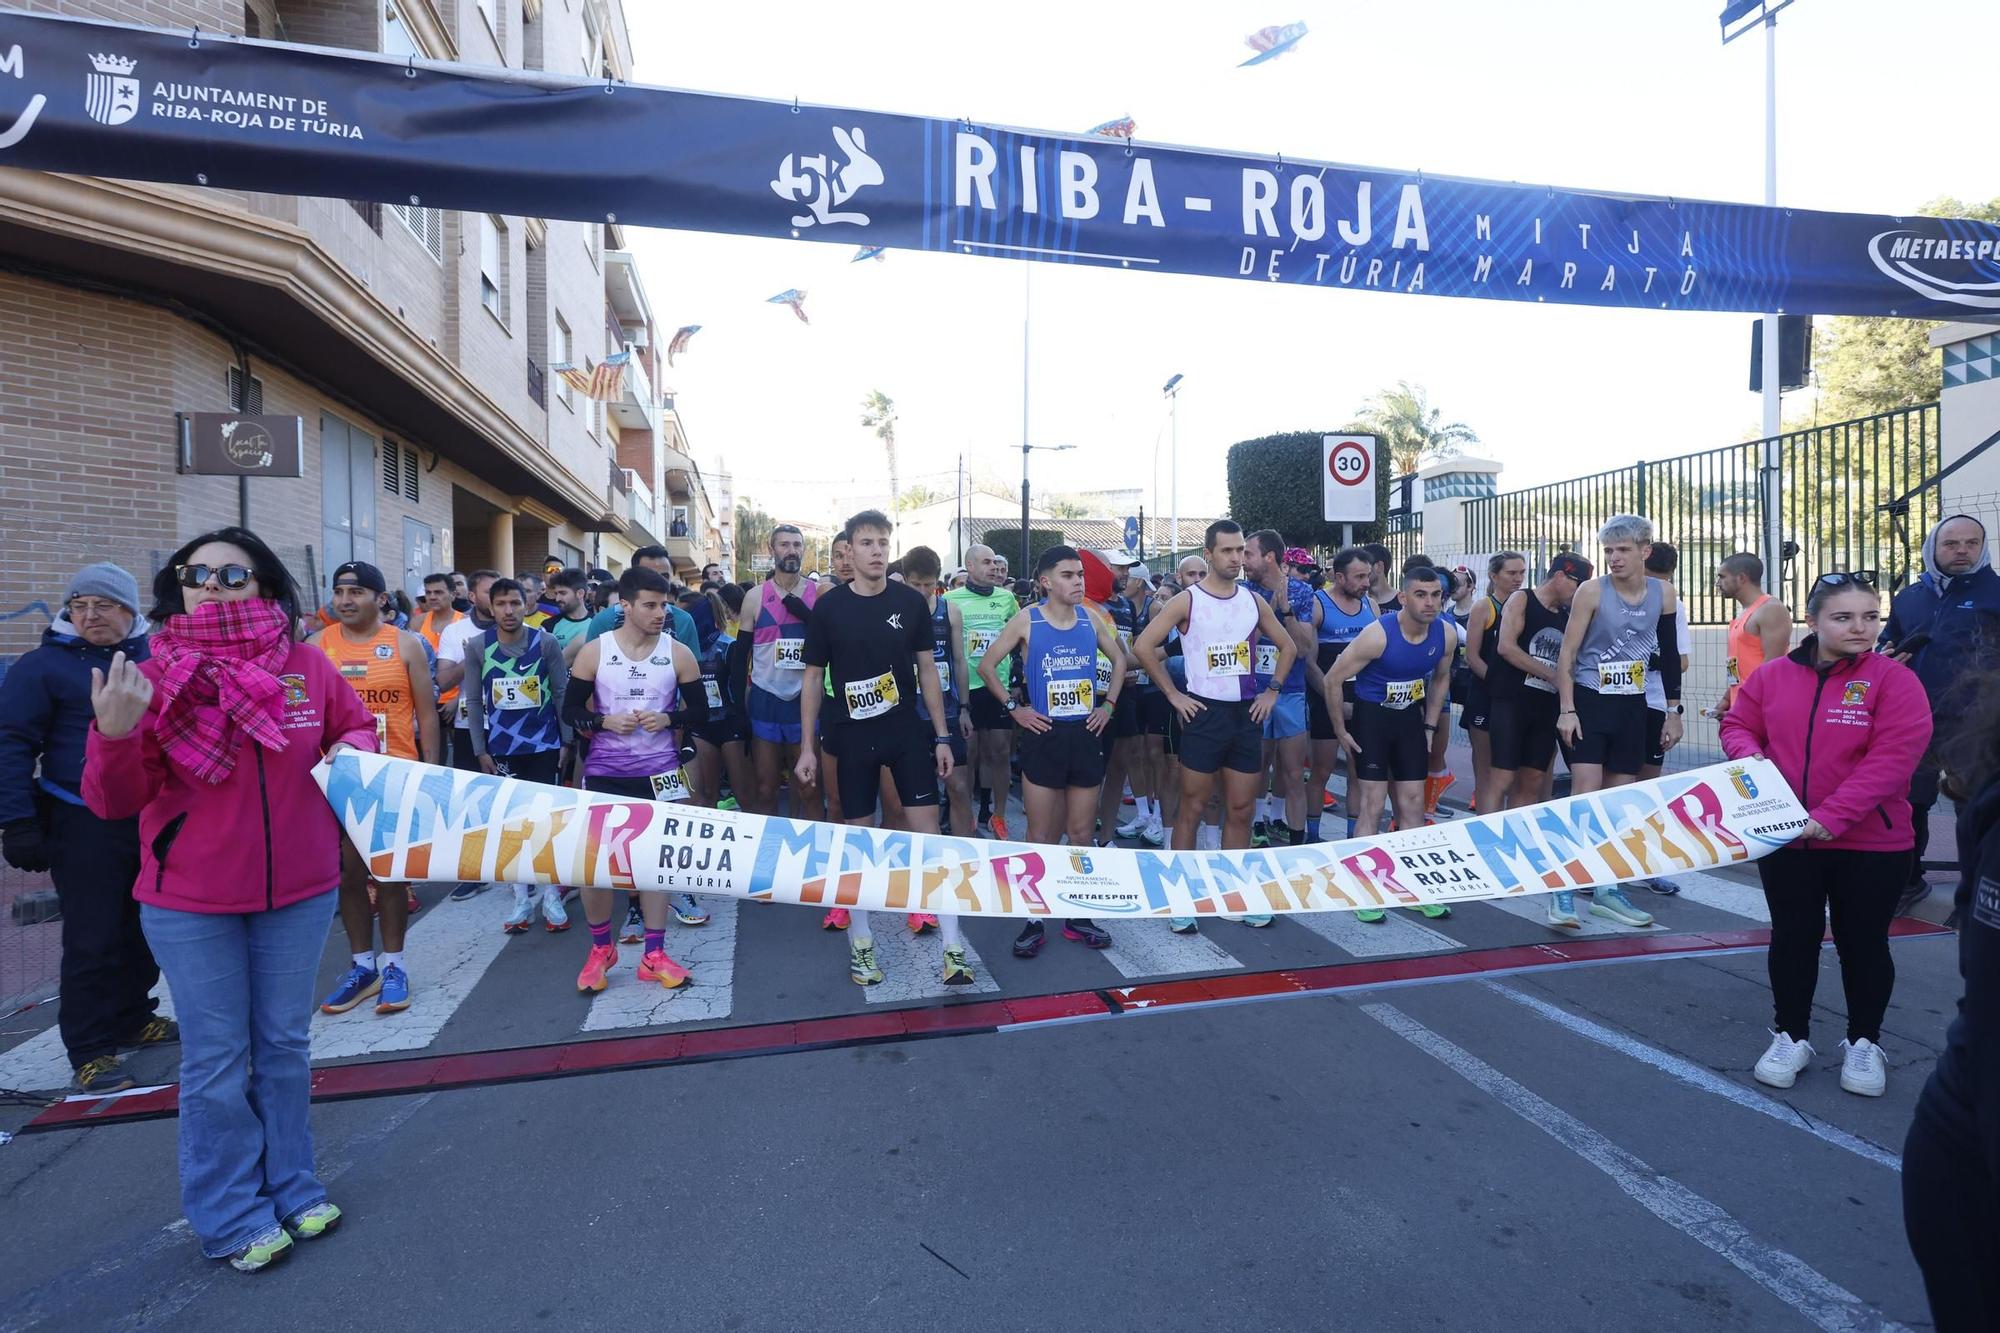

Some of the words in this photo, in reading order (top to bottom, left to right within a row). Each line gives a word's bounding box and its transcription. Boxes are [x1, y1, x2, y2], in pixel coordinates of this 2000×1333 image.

[153, 81, 297, 111] AJUNTAMENT
[303, 99, 328, 116] DE
[152, 103, 263, 128] RIBA-ROJA
[269, 116, 296, 132] DE
[301, 117, 364, 140] TÚRIA
[1476, 214, 1693, 257] MITJA
[1240, 246, 1284, 279] DE
[1316, 249, 1425, 291] TÚRIA
[1338, 456, 1361, 471] 30
[1600, 629, 1638, 661] SILLA
[1074, 655, 1090, 666] SANZ
[1210, 652, 1238, 667] 5917
[1263, 655, 1269, 666] 2
[1604, 672, 1634, 685] 6013
[355, 689, 400, 704] EROS
[507, 688, 515, 700] 5
[849, 689, 883, 709] 6008
[1052, 691, 1081, 706] 5991
[1389, 691, 1413, 703] 5214
[654, 774, 683, 792] 5994
[664, 818, 753, 842] RIBA-
[1400, 849, 1476, 869] RIBA-
[658, 874, 675, 885] DE
[686, 875, 732, 889] TÚRIA
[1069, 893, 1139, 901] METAESPORT
